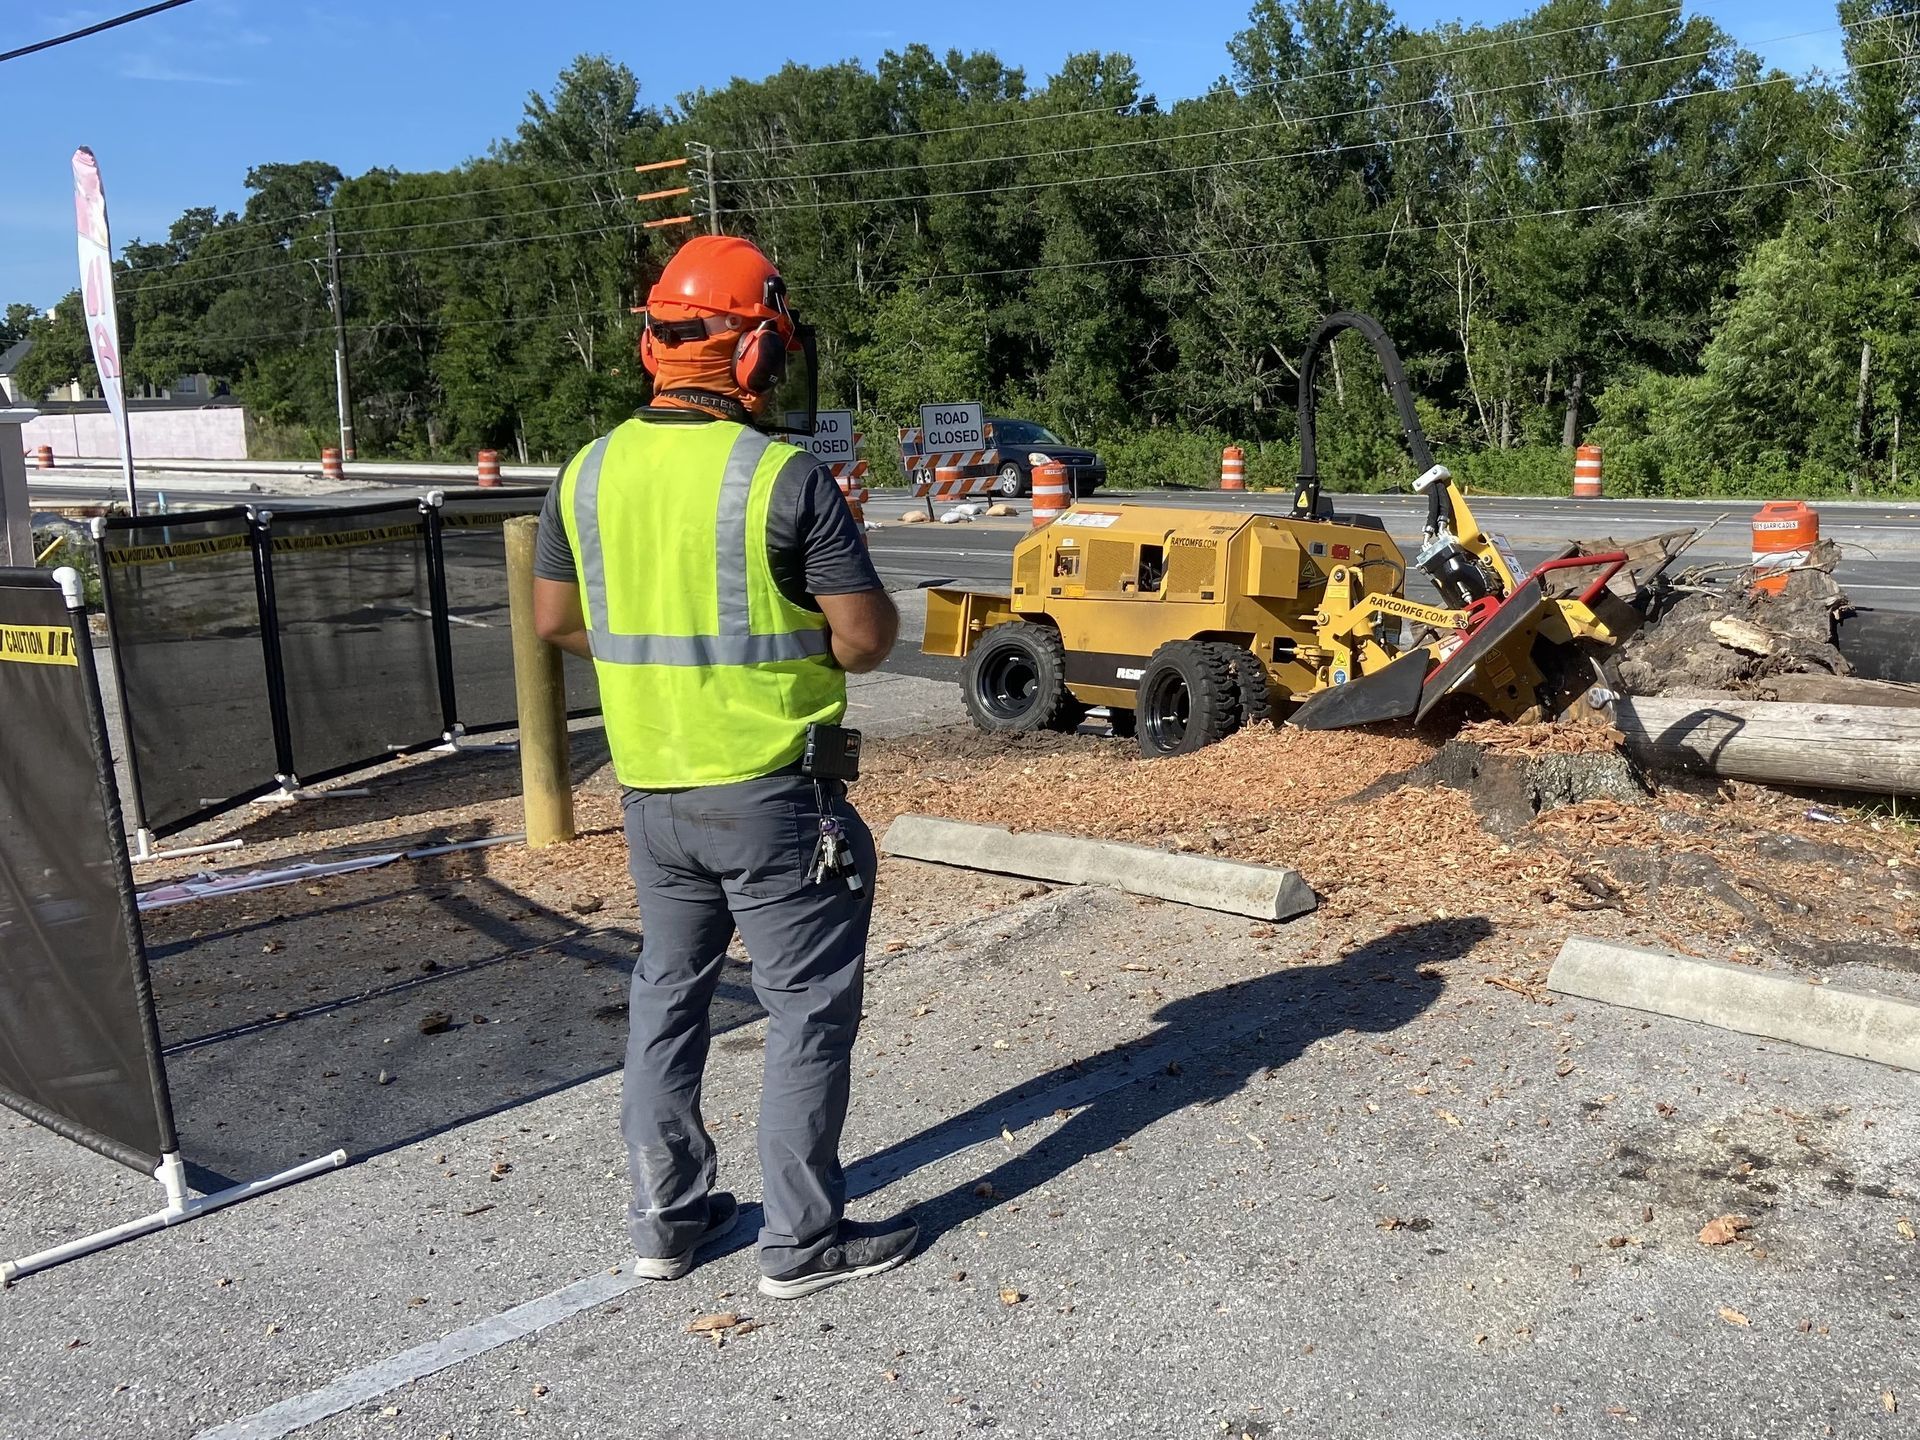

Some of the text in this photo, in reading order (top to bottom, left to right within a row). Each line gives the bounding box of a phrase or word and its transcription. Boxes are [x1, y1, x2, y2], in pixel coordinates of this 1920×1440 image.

[935, 411, 969, 425] ROAD
[929, 430, 979, 445] CLOSED
[1171, 537, 1218, 548] RAYCOMFG.COM
[1369, 596, 1448, 623] RAYCOMFG.COM
[5, 630, 43, 654] CAUTION
